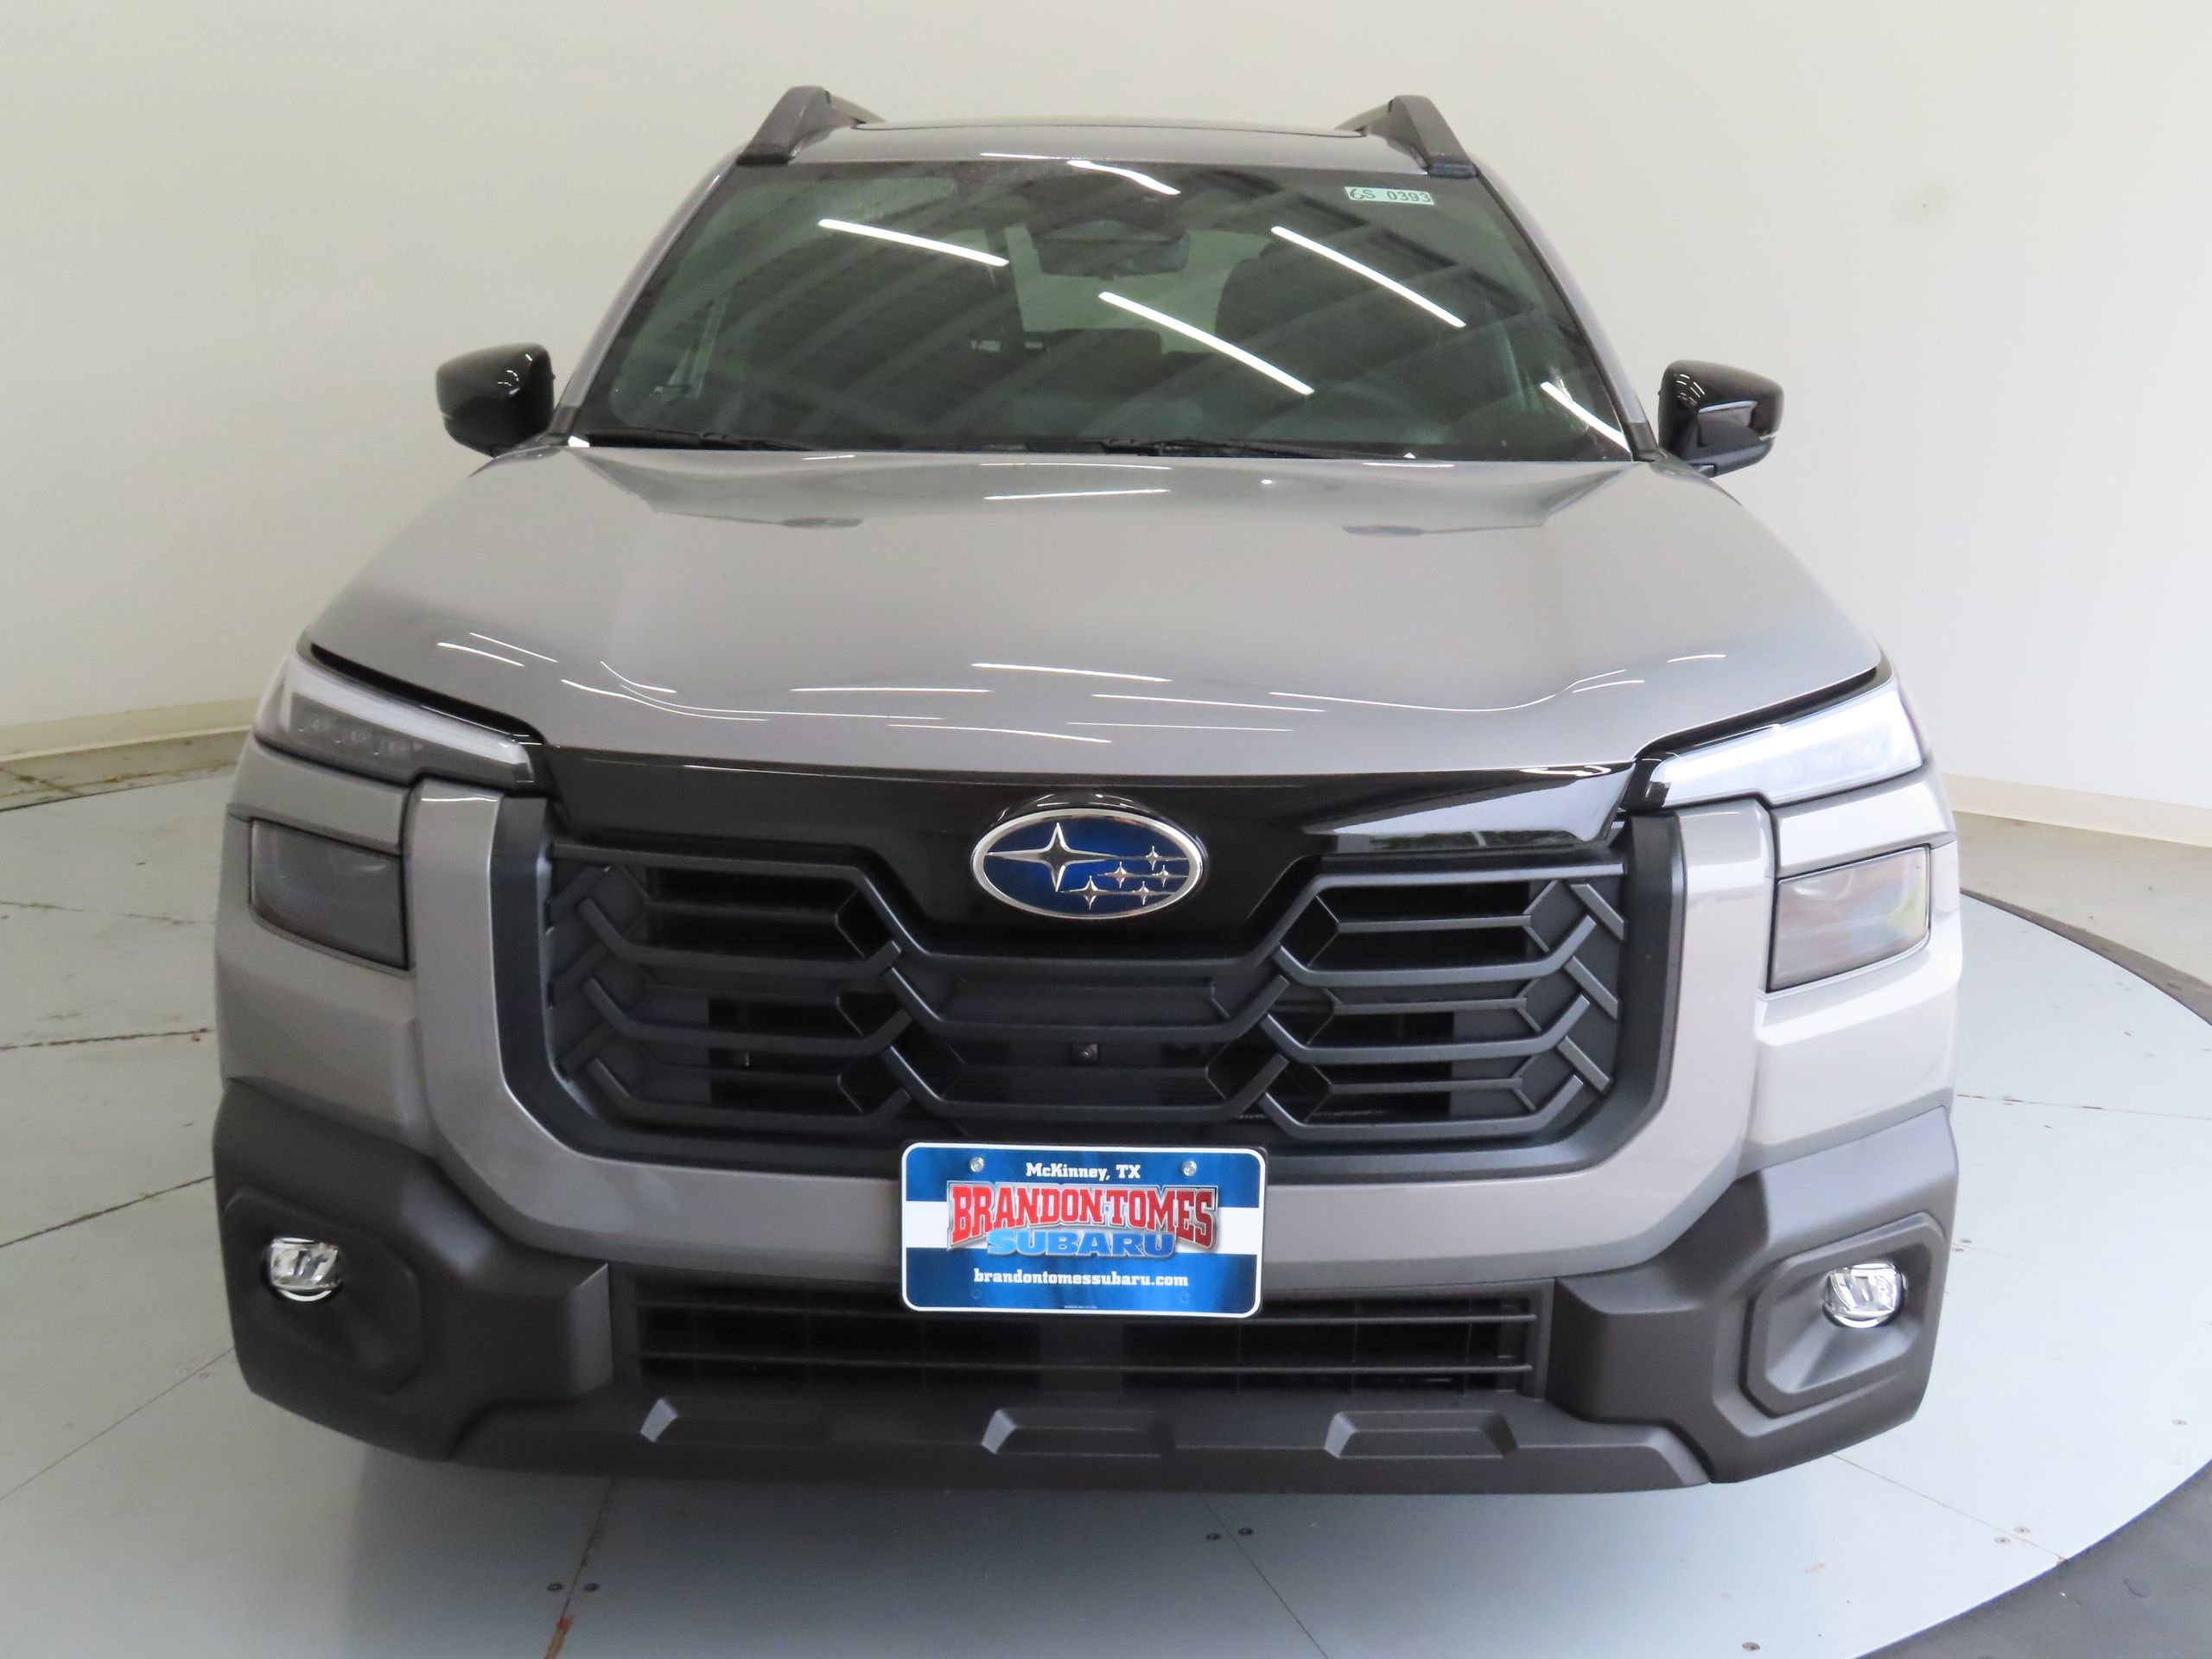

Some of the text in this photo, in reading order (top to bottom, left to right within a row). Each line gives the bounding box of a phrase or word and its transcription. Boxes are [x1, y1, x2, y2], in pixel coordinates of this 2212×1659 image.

[1386, 191, 1432, 202] 0393
[1026, 1162, 1141, 1181] McKinney, TX
[951, 1185, 1216, 1246] BRANDON TOMES
[987, 1229, 1176, 1256] SUBARU
[974, 1268, 1189, 1287] brandontomessubaru.com
